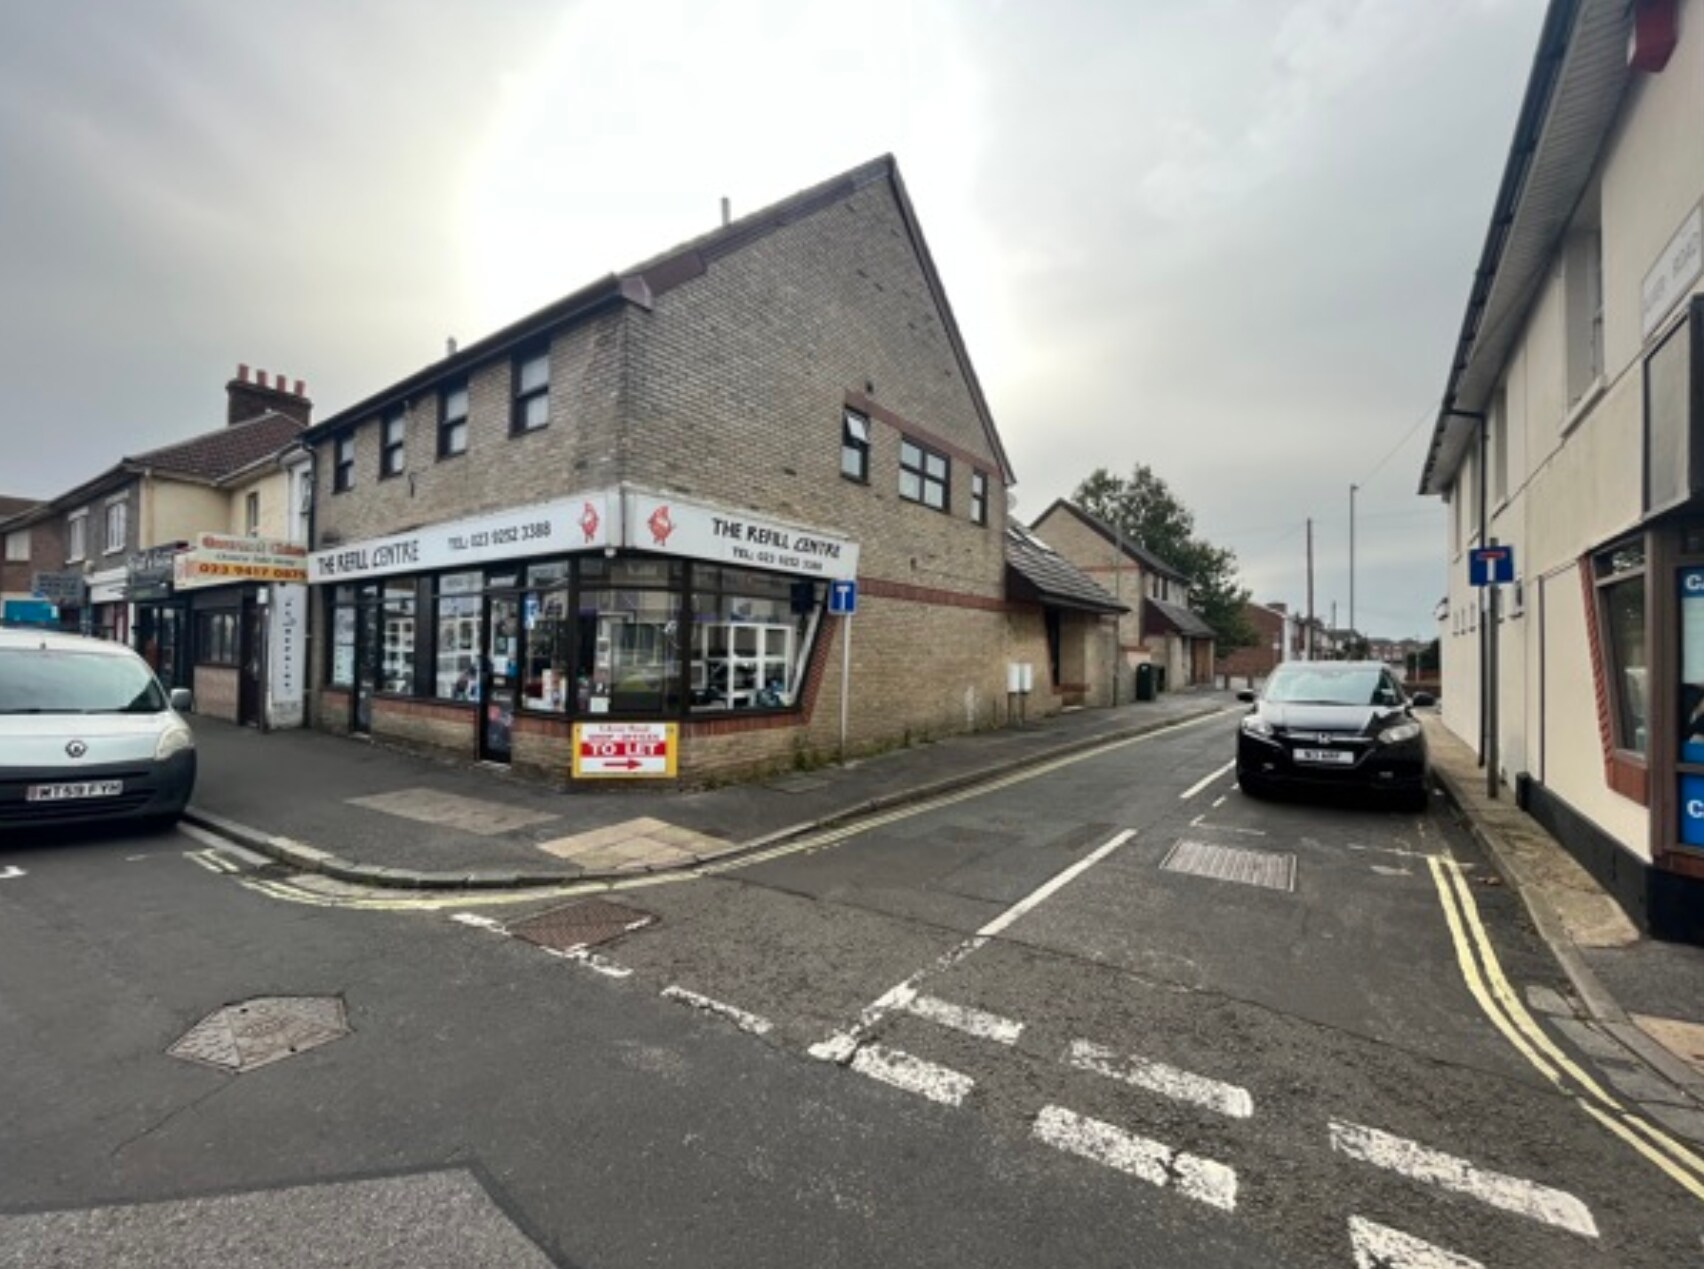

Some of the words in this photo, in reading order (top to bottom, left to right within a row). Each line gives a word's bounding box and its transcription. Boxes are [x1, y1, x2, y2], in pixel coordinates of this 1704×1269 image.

[471, 531, 488, 547] 023
[712, 517, 742, 539] THE
[747, 526, 789, 550] REFILL
[793, 537, 840, 559] CENTRE
[318, 554, 335, 575] THE
[337, 549, 368, 572] REFILL
[373, 540, 419, 567] CENTRE
[199, 563, 228, 575] 023
[588, 742, 617, 757] TO
[624, 742, 659, 757] LET
